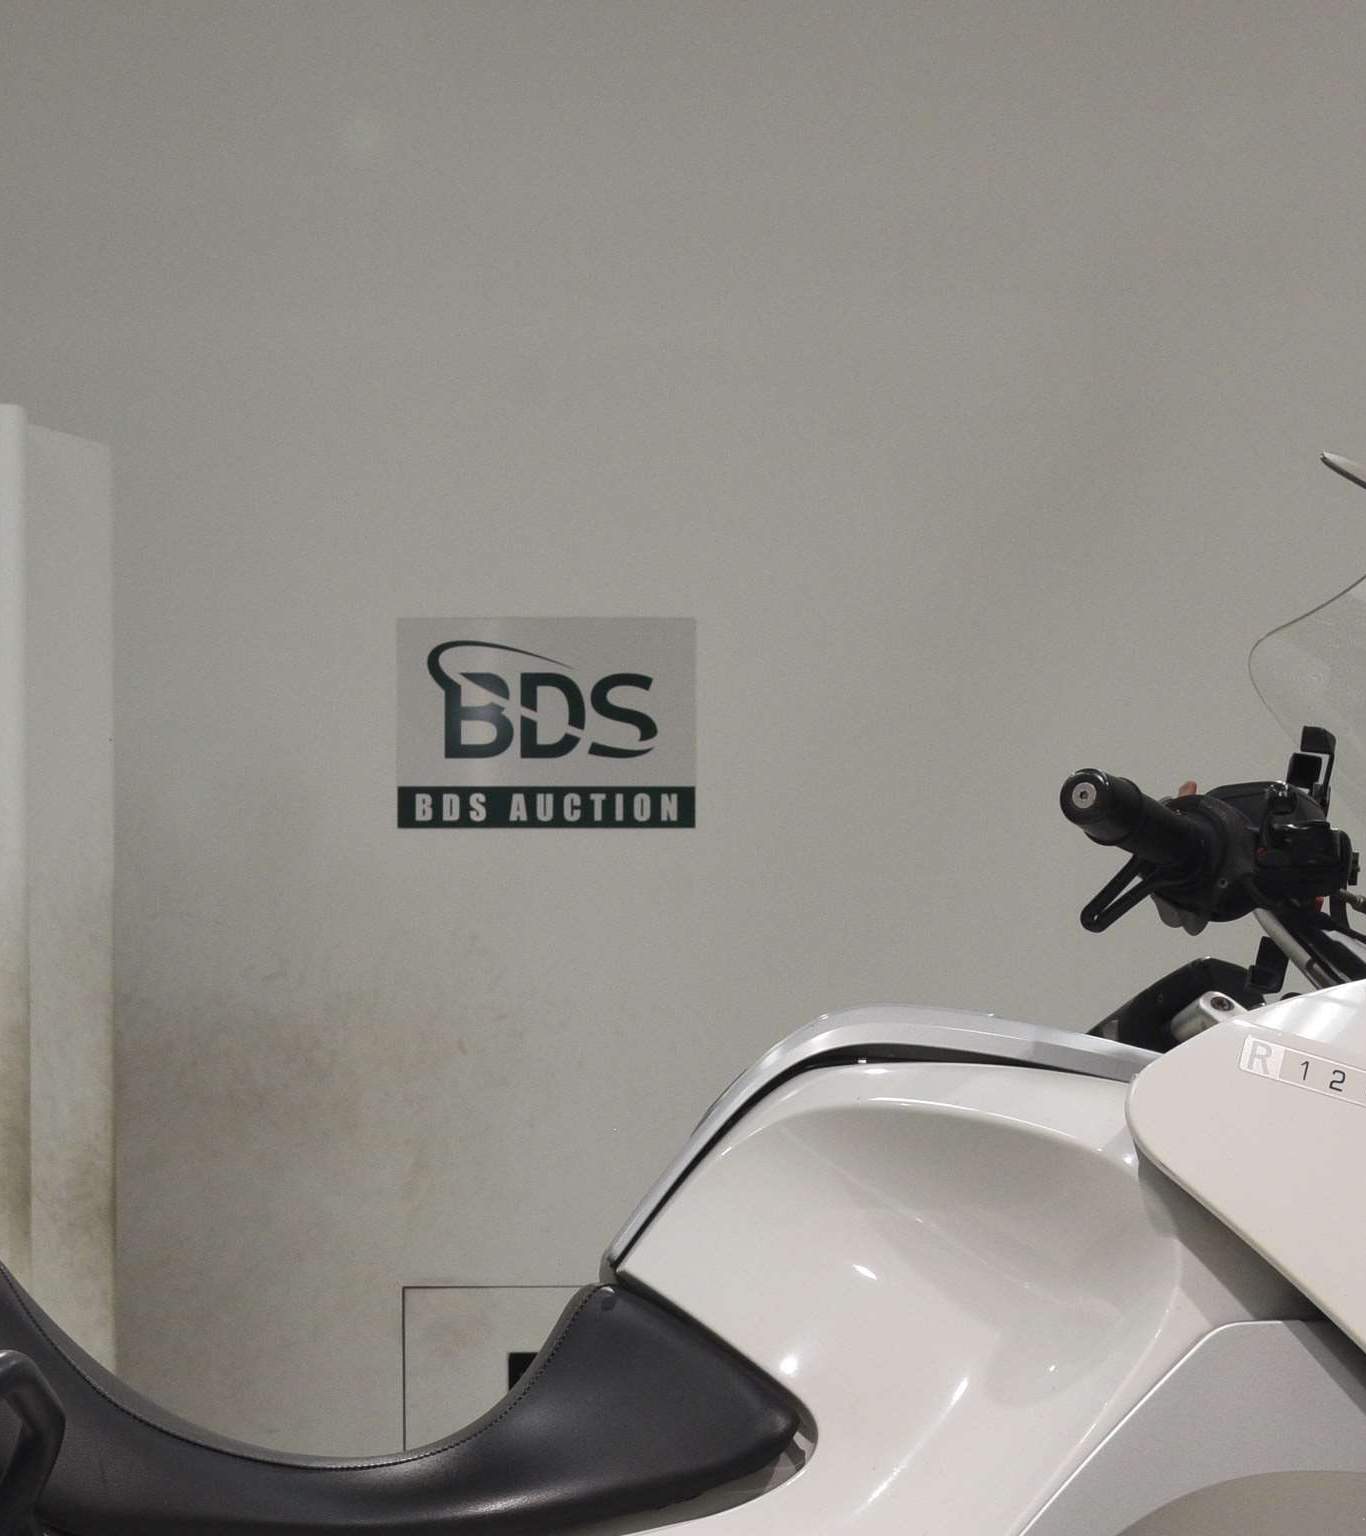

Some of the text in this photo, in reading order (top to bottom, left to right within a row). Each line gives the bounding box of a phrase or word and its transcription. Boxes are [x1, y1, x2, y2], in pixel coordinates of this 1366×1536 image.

[427, 640, 658, 759] BDS
[415, 792, 679, 822] BDS AUCTION
[1248, 1041, 1273, 1075] R
